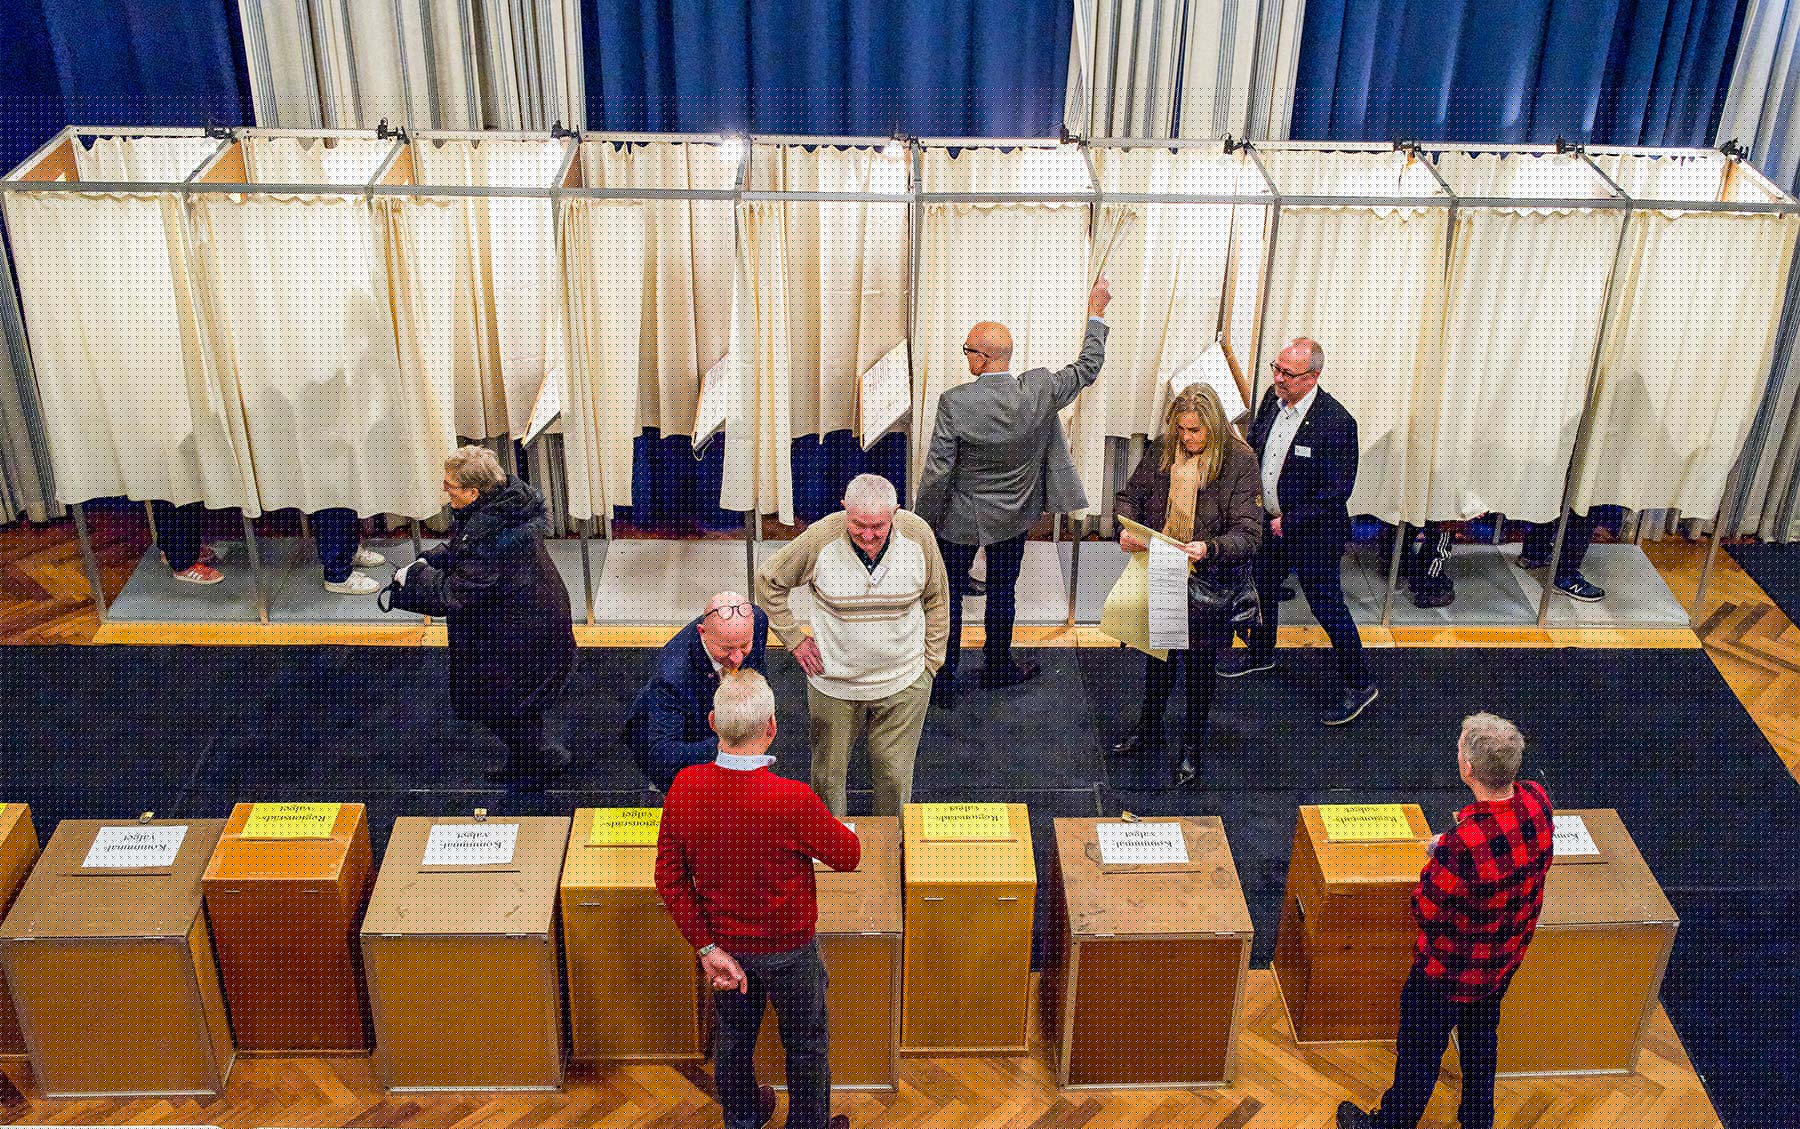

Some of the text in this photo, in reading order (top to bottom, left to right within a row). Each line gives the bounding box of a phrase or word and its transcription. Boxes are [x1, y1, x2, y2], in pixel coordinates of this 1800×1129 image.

[280, 804, 311, 813] valget
[622, 810, 653, 819] valget
[123, 833, 156, 843] valget
[457, 831, 490, 840] valget
[1125, 831, 1157, 839] valget
[440, 840, 502, 849] Kommunal-
